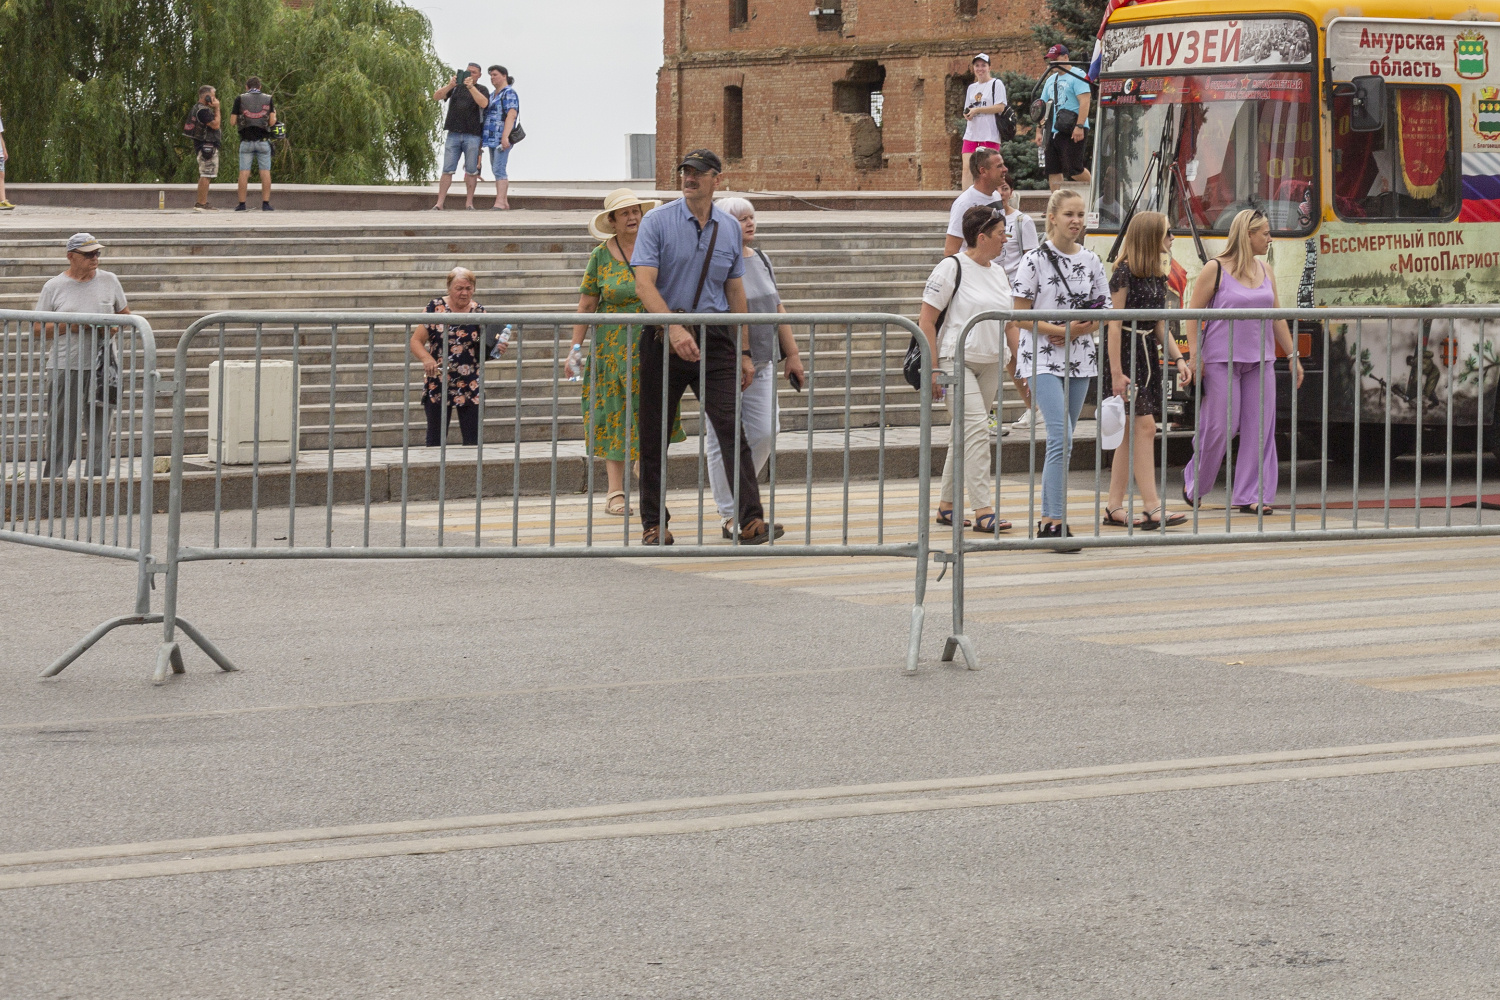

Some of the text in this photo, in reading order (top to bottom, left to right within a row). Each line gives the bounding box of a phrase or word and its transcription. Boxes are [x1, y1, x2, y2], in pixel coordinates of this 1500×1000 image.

[1140, 20, 1242, 67] МУЗЕЙ
[1359, 27, 1445, 54] Амурская
[1369, 55, 1442, 78] область
